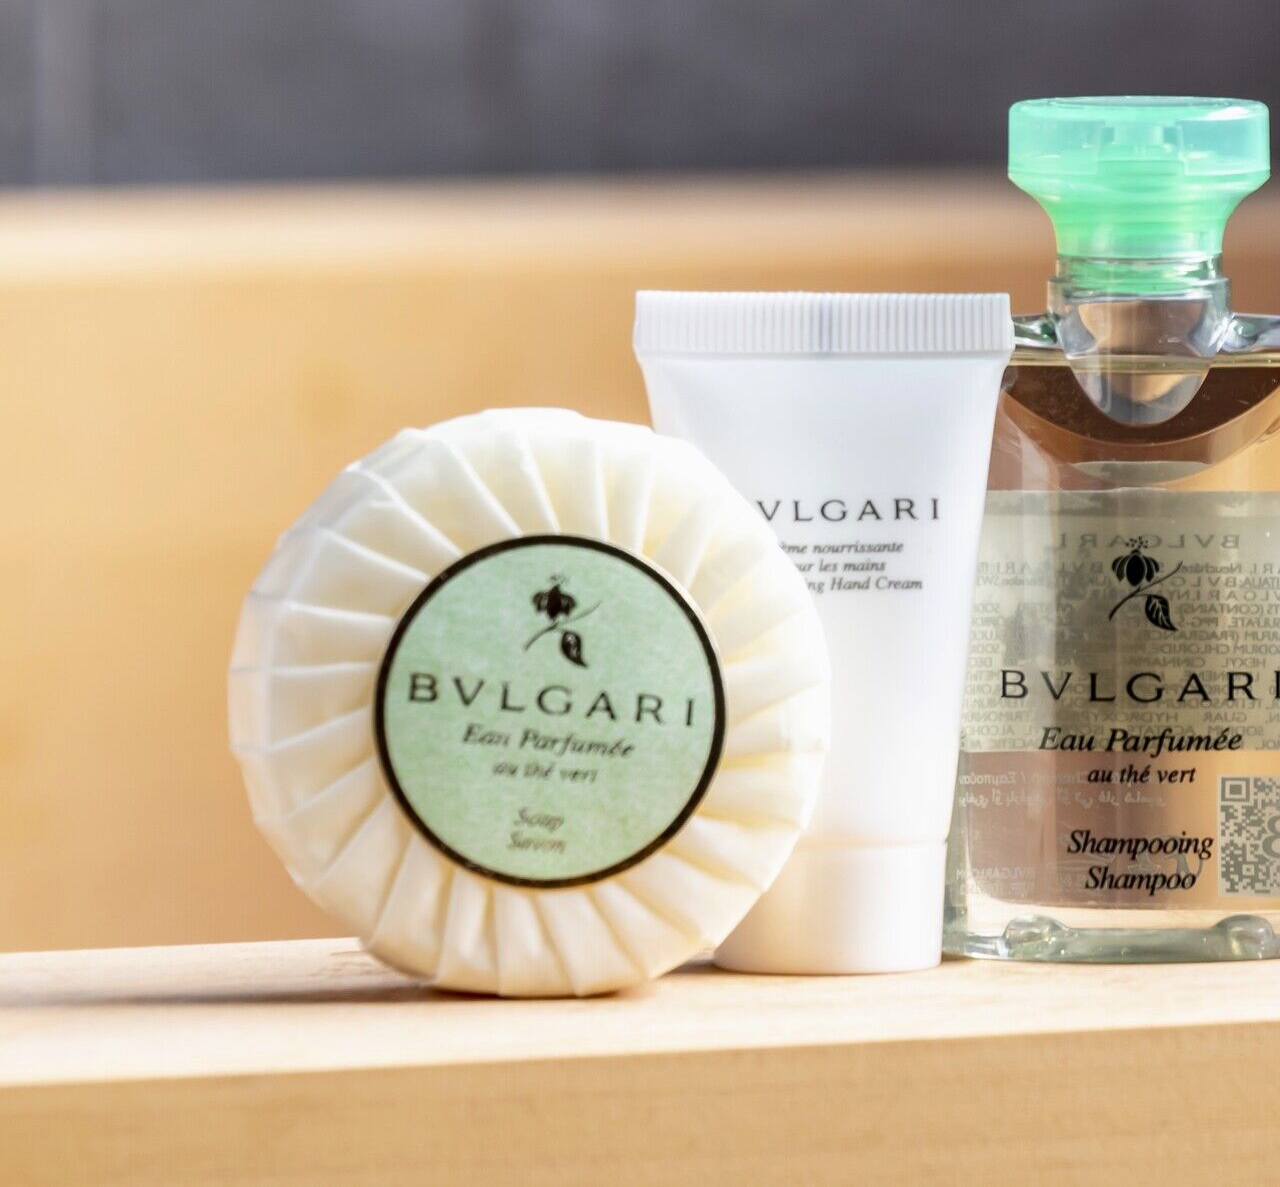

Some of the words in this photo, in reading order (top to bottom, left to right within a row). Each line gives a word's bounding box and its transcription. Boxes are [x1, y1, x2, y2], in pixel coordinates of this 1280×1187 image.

[756, 498, 939, 522] VLGARI
[812, 540, 904, 554] nourrissante
[819, 558, 838, 572] les
[843, 559, 886, 572] mains
[830, 577, 870, 590] Hand
[875, 576, 923, 590] Cream
[408, 673, 695, 726] BVLGARI
[463, 723, 509, 748] Eau
[519, 730, 636, 759] Parfumée
[1039, 726, 1095, 752] Eau
[1105, 727, 1243, 757] Parfumée
[493, 762, 518, 778] au
[1087, 769, 1112, 783] au
[1119, 764, 1150, 783] thé
[1157, 767, 1196, 783] vert
[1067, 830, 1214, 859] Shampooing
[1085, 866, 1196, 896] Shampoo
